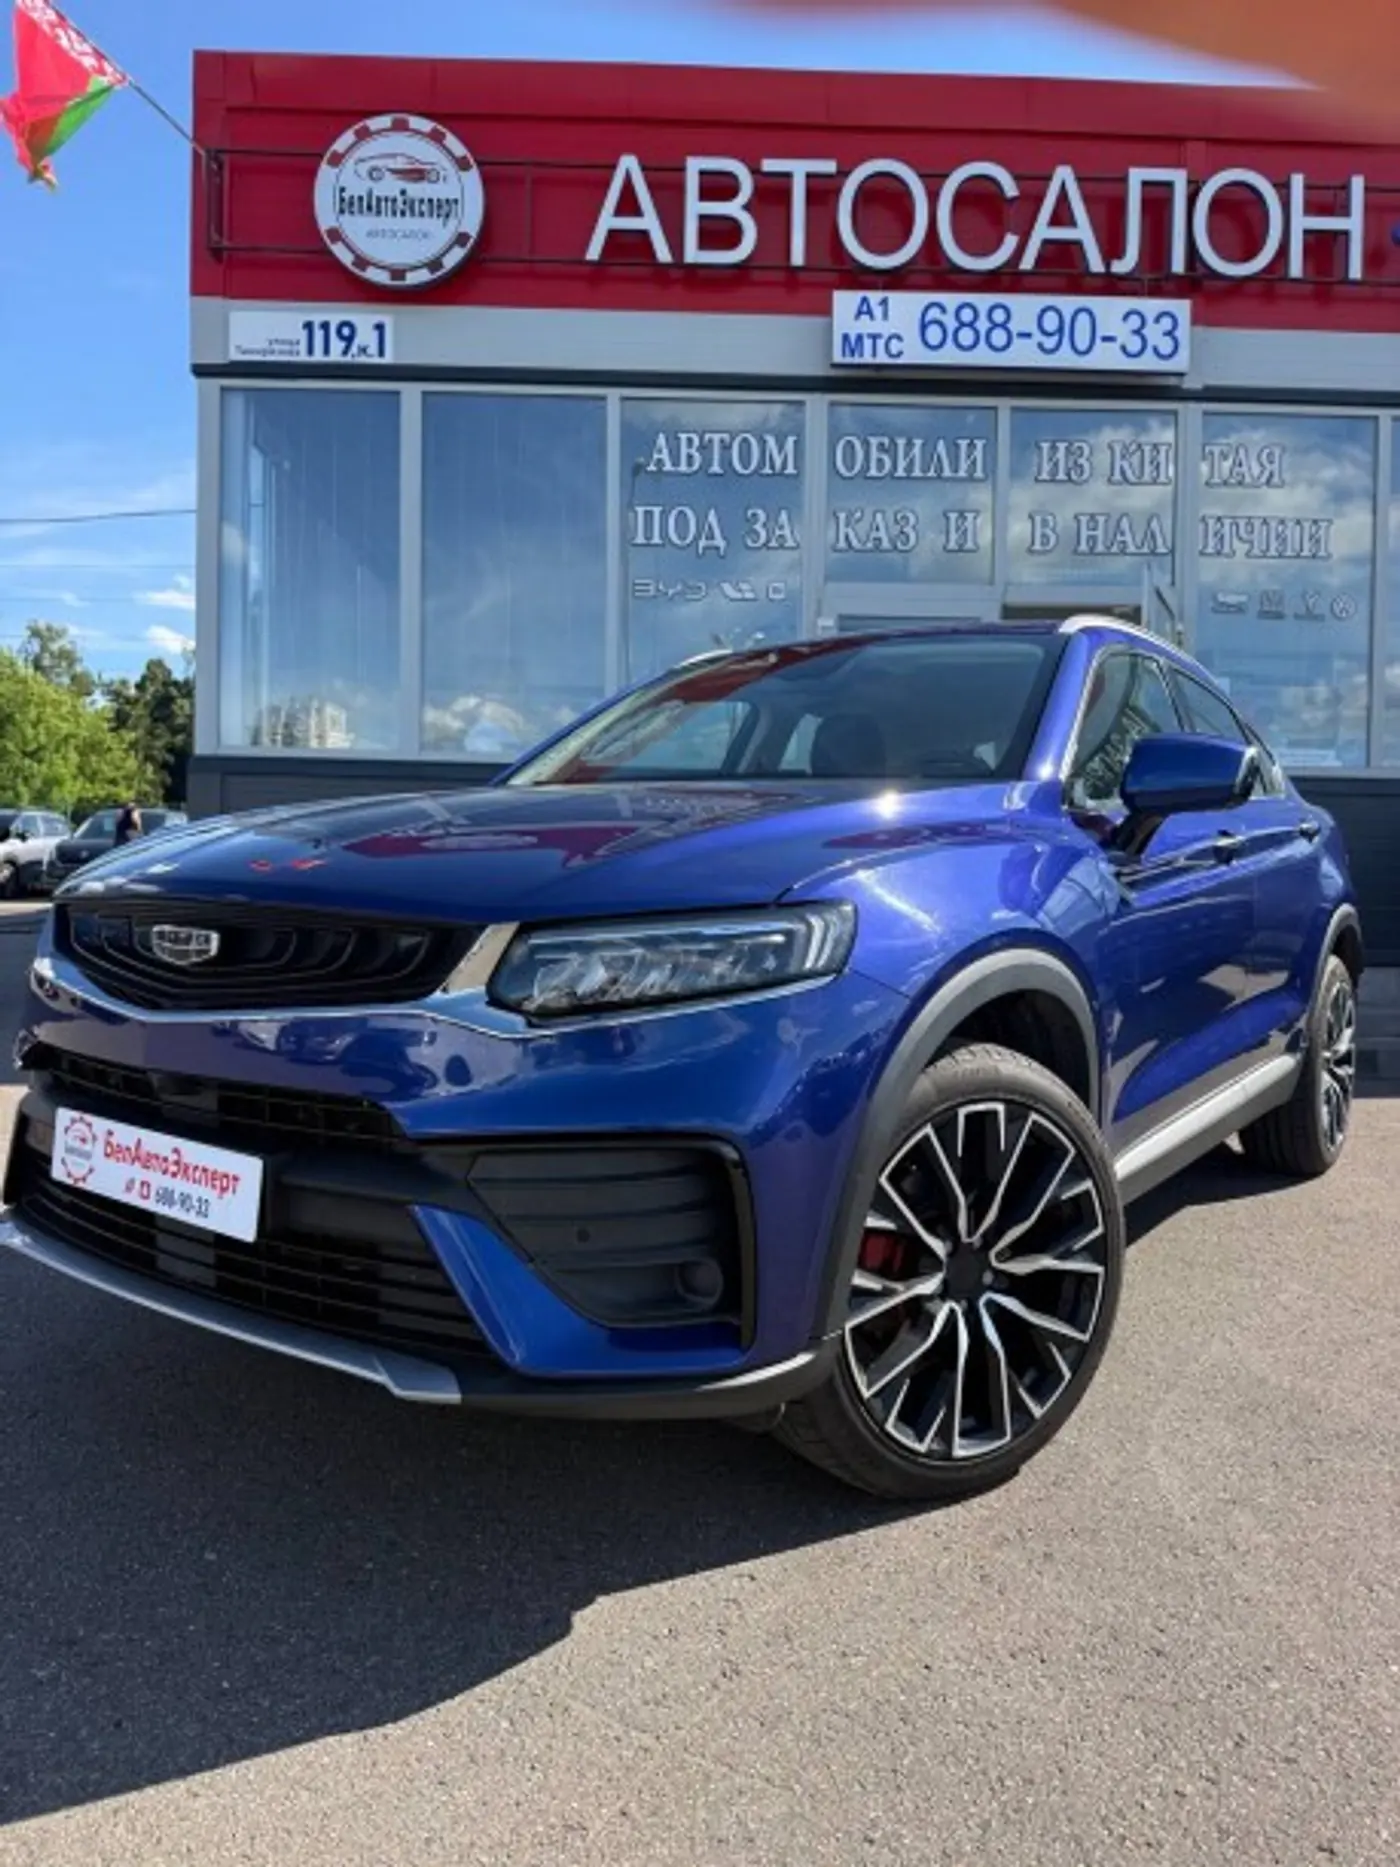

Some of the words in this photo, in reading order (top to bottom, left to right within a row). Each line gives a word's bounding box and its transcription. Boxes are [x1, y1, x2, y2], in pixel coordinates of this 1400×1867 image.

[338, 185, 460, 228] БелАвтоЭксперт
[585, 153, 1365, 281] АВТОСАЛОН
[853, 295, 891, 322] A1
[918, 301, 1180, 361] 688-90-33
[841, 332, 905, 360] МТС
[1035, 439, 1093, 483] ИЗ
[631, 505, 728, 557] ПОД
[946, 510, 982, 551] И
[1027, 511, 1059, 553] В
[103, 1130, 241, 1199] БелАвтоЭксперт
